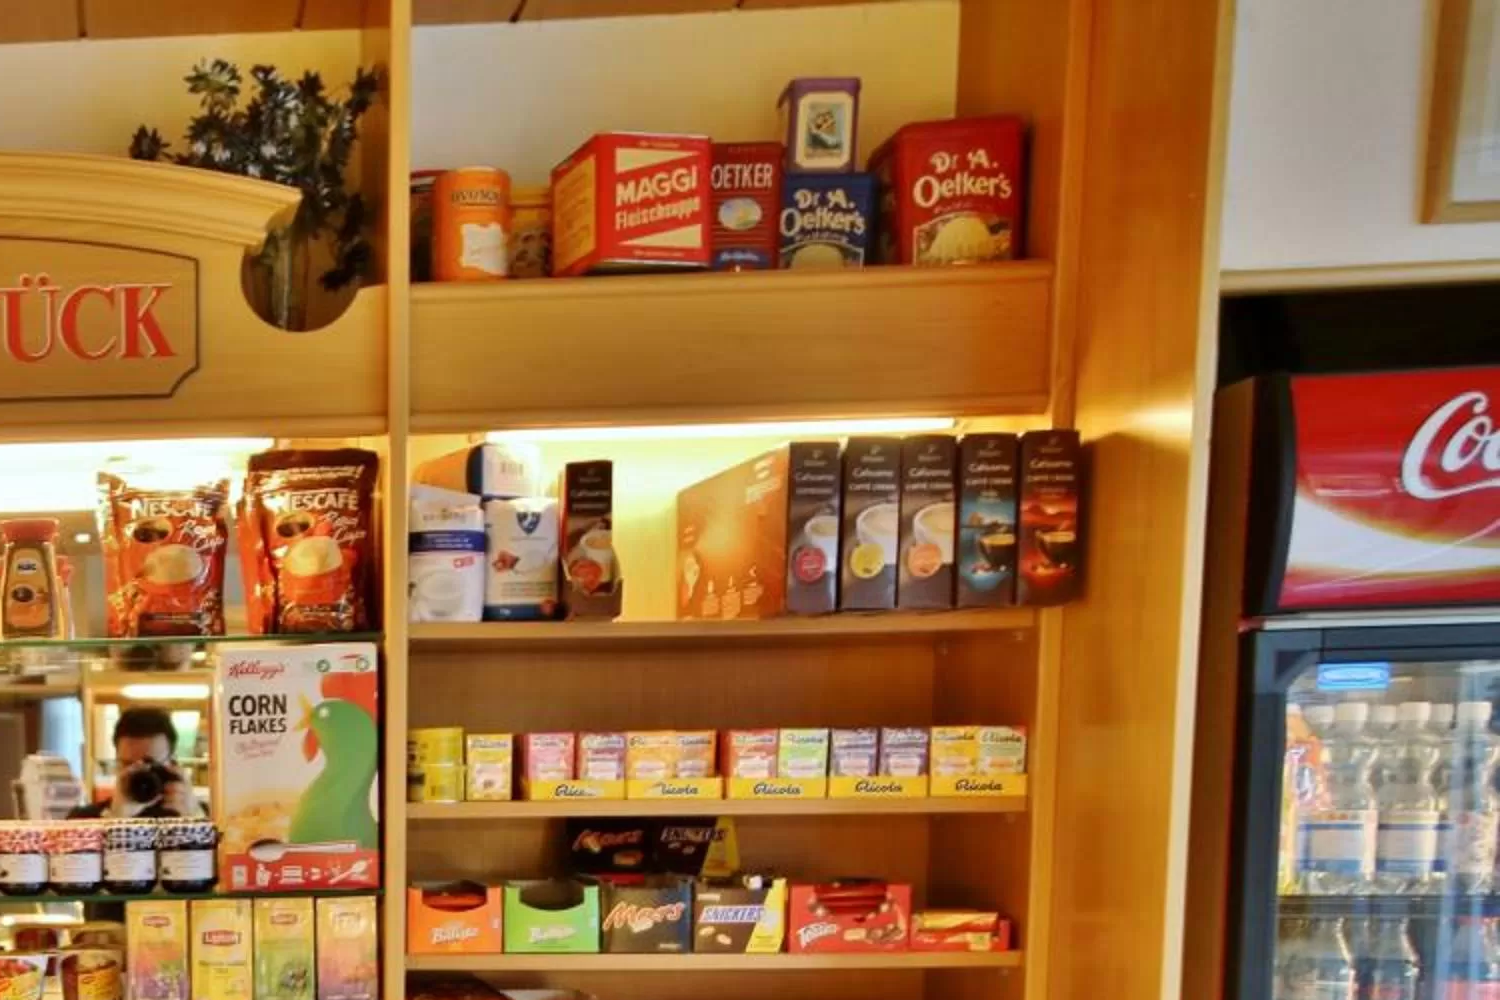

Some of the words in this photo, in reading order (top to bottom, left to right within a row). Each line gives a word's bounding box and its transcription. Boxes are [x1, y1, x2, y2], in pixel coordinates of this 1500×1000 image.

[614, 164, 698, 207] MAGGI
[711, 162, 773, 190] OETKER
[913, 171, 1012, 208] Oetker's
[780, 207, 865, 237] Oetker's
[228, 694, 288, 717] CORN
[229, 717, 288, 735] FLAKES
[753, 782, 802, 796] Ricola
[855, 780, 903, 793] Ricola
[955, 778, 1003, 791] Ricola
[603, 901, 686, 931] Mars
[702, 906, 764, 922] SNICKERS
